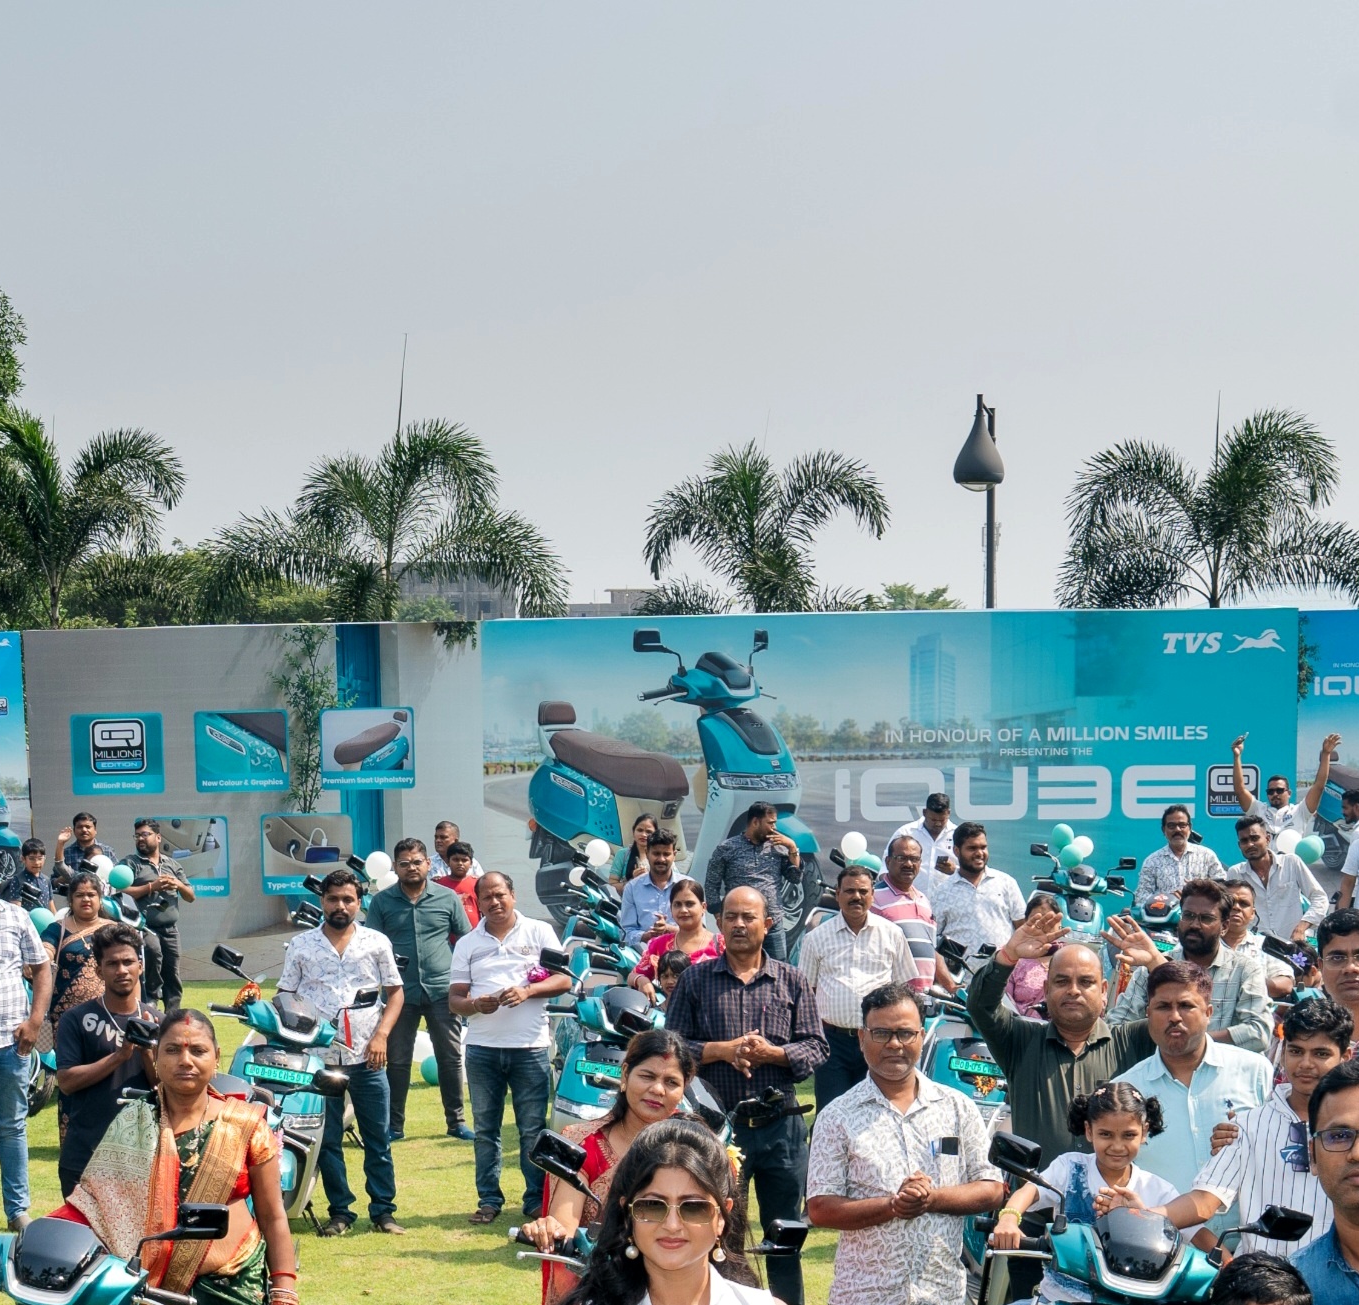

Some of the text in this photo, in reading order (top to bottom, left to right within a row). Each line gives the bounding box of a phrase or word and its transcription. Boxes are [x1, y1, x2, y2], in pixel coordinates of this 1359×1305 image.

[1163, 632, 1223, 654] TVS
[885, 726, 1208, 743] IN HONOUR OF A MILLION SMILES
[95, 750, 142, 759] MILLIONR
[1000, 747, 1092, 757] PRESENTING THE
[251, 778, 283, 786] Graphics
[375, 776, 414, 785] Upholstery
[196, 884, 224, 892] Storage
